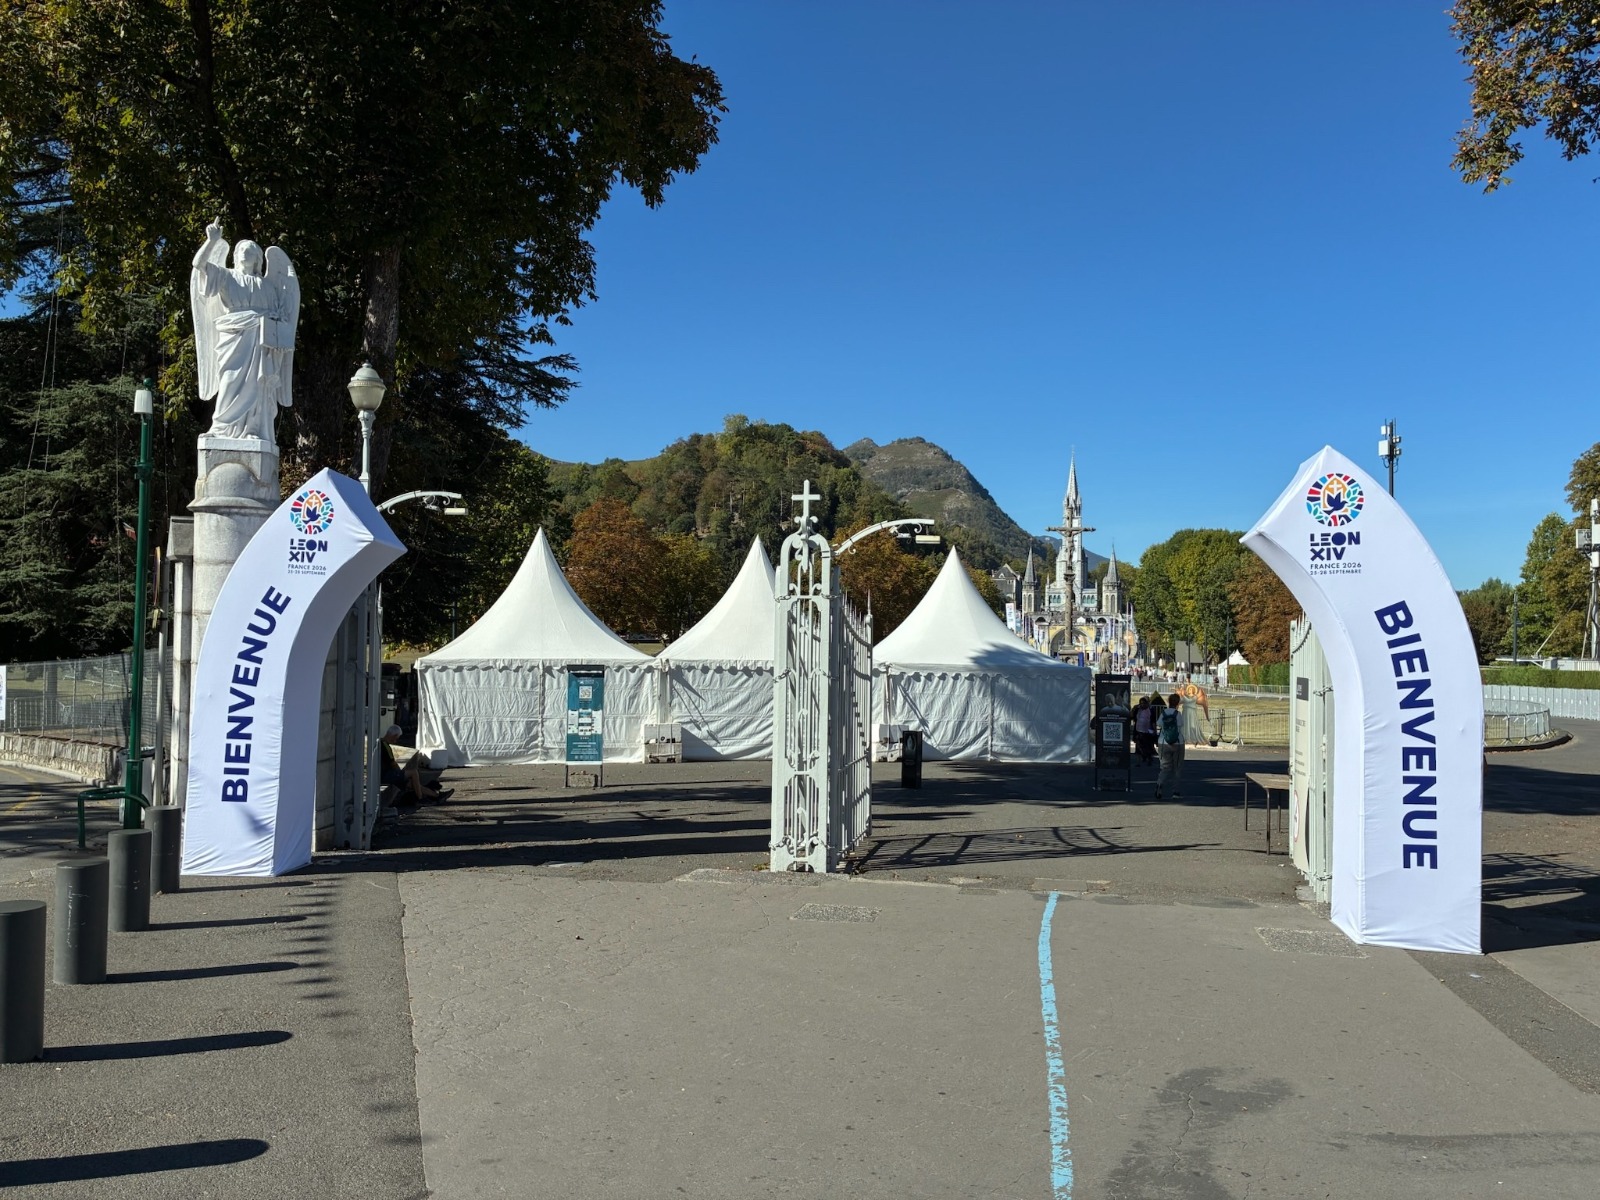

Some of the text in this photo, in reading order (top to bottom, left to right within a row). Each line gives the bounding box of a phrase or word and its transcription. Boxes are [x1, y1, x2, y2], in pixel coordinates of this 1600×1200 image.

[290, 538, 328, 552] LEON
[1310, 531, 1361, 546] LEON
[289, 550, 316, 563] XIV
[1310, 546, 1346, 561] XIV
[1310, 562, 1340, 570] FRANCE
[221, 585, 291, 802] BIENVENUE
[1374, 600, 1438, 869] BIENVENUE
